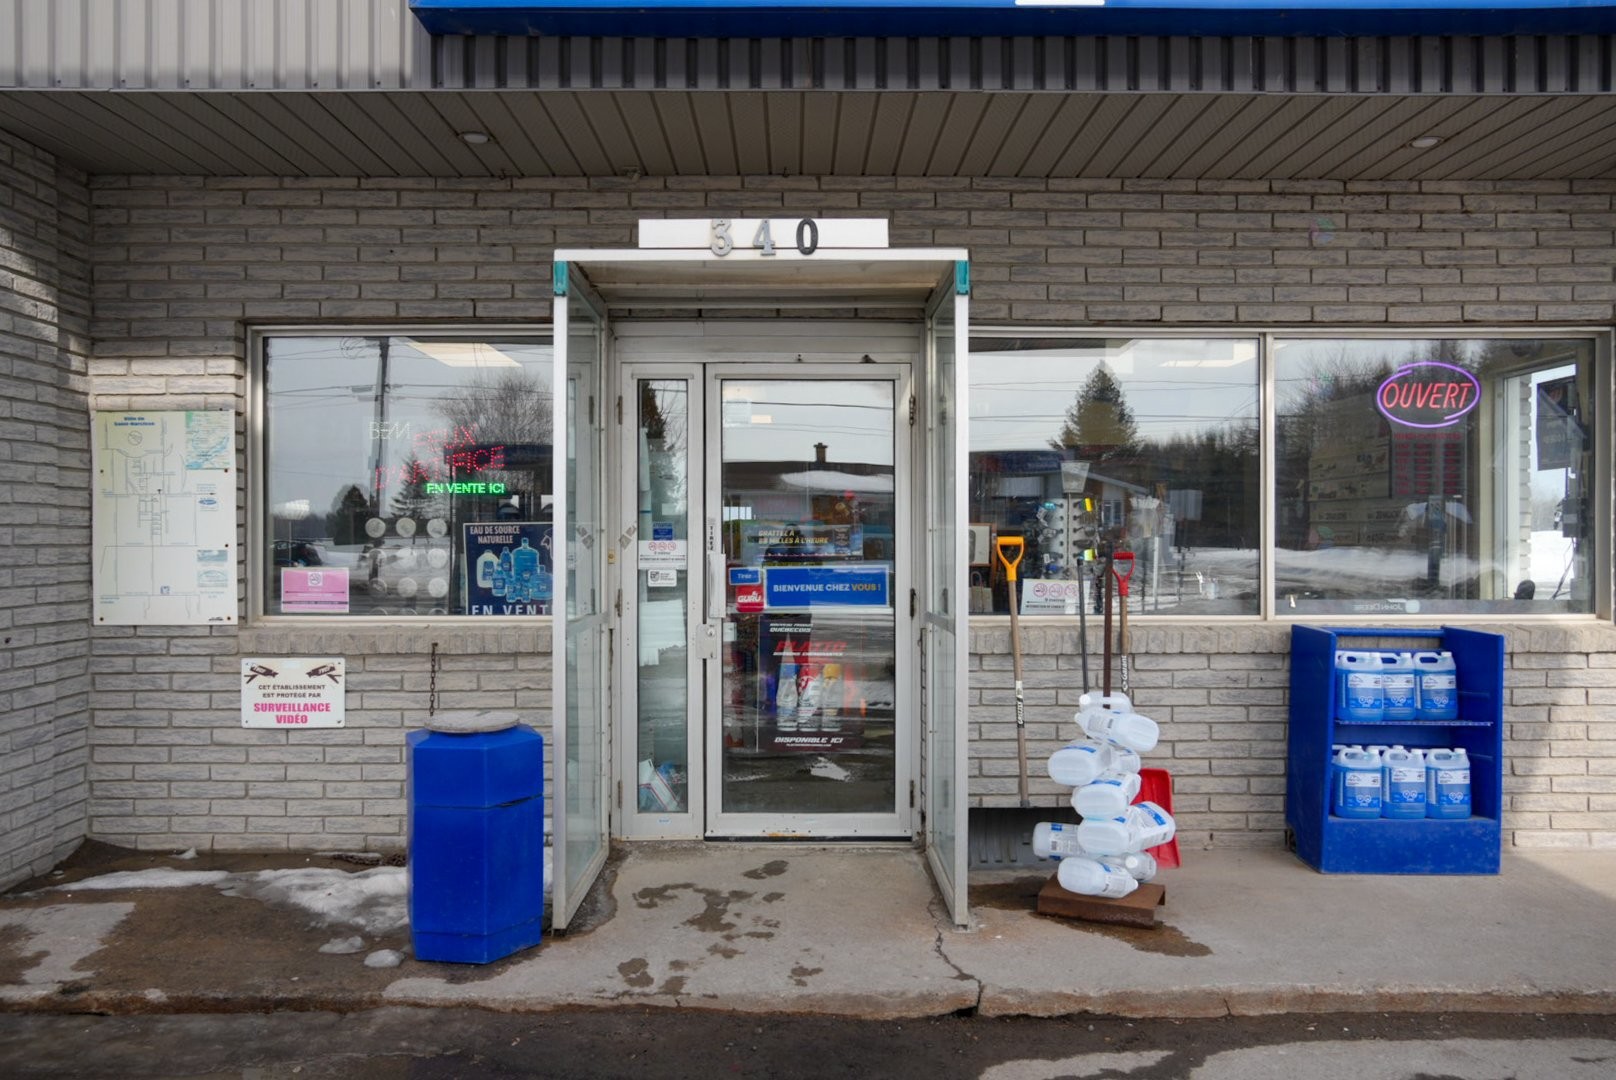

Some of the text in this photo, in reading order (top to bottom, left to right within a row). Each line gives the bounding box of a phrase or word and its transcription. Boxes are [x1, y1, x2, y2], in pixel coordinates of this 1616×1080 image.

[711, 218, 819, 256] 340
[1382, 382, 1473, 409] OUVERT
[426, 483, 505, 494] EN VENTE ICI
[470, 526, 520, 535] EAU DE SOURCE
[478, 535, 513, 544] NATURELLE
[773, 584, 824, 592] BIENVENUE
[825, 584, 850, 592] CHEZ
[472, 604, 548, 615] EN VENT
[254, 703, 331, 712] SURVEILLANCE
[276, 713, 308, 724] VIDÉO
